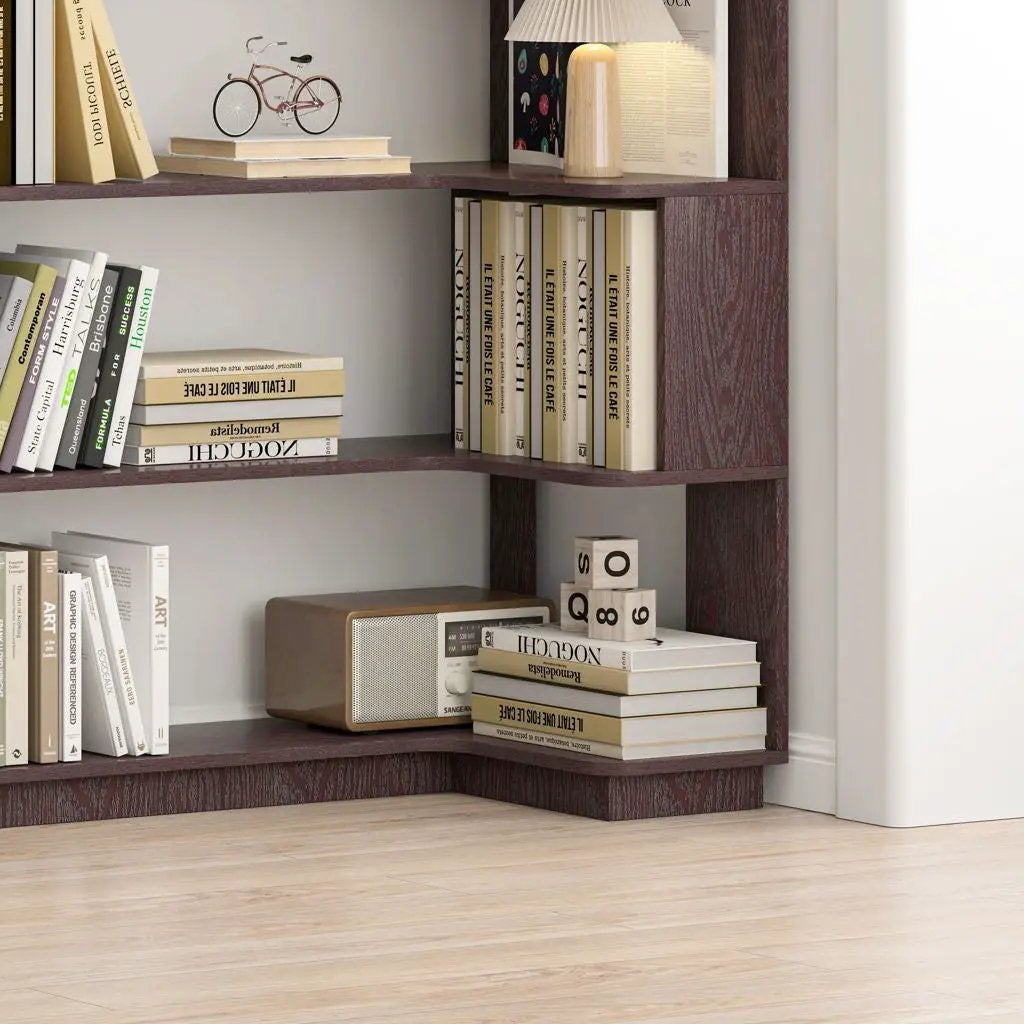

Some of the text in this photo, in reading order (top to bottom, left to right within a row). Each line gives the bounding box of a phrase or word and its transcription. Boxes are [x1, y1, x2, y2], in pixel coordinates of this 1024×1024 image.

[6, 298, 23, 332] Columbia
[18, 292, 46, 365] Contemporan
[29, 297, 60, 385] FORM STYLE
[72, 278, 100, 358] TALKS
[130, 287, 153, 350] Houston
[484, 263, 494, 405] IL ÉTAIT UNE FOIS LE CAFÉ
[516, 253, 524, 392] NOGUCHI
[28, 276, 85, 455] State Capital Harrisburg
[60, 368, 77, 408] TED
[69, 285, 113, 454] Queensland Brisbane
[96, 286, 135, 450] FORMULA FOR SUCCESS
[43, 601, 56, 634] ART
[155, 596, 167, 628] ART
[568, 592, 588, 624] Q
[596, 608, 618, 626] 8
[518, 635, 601, 665] NOGUCHI
[528, 664, 581, 684] Remodelista
